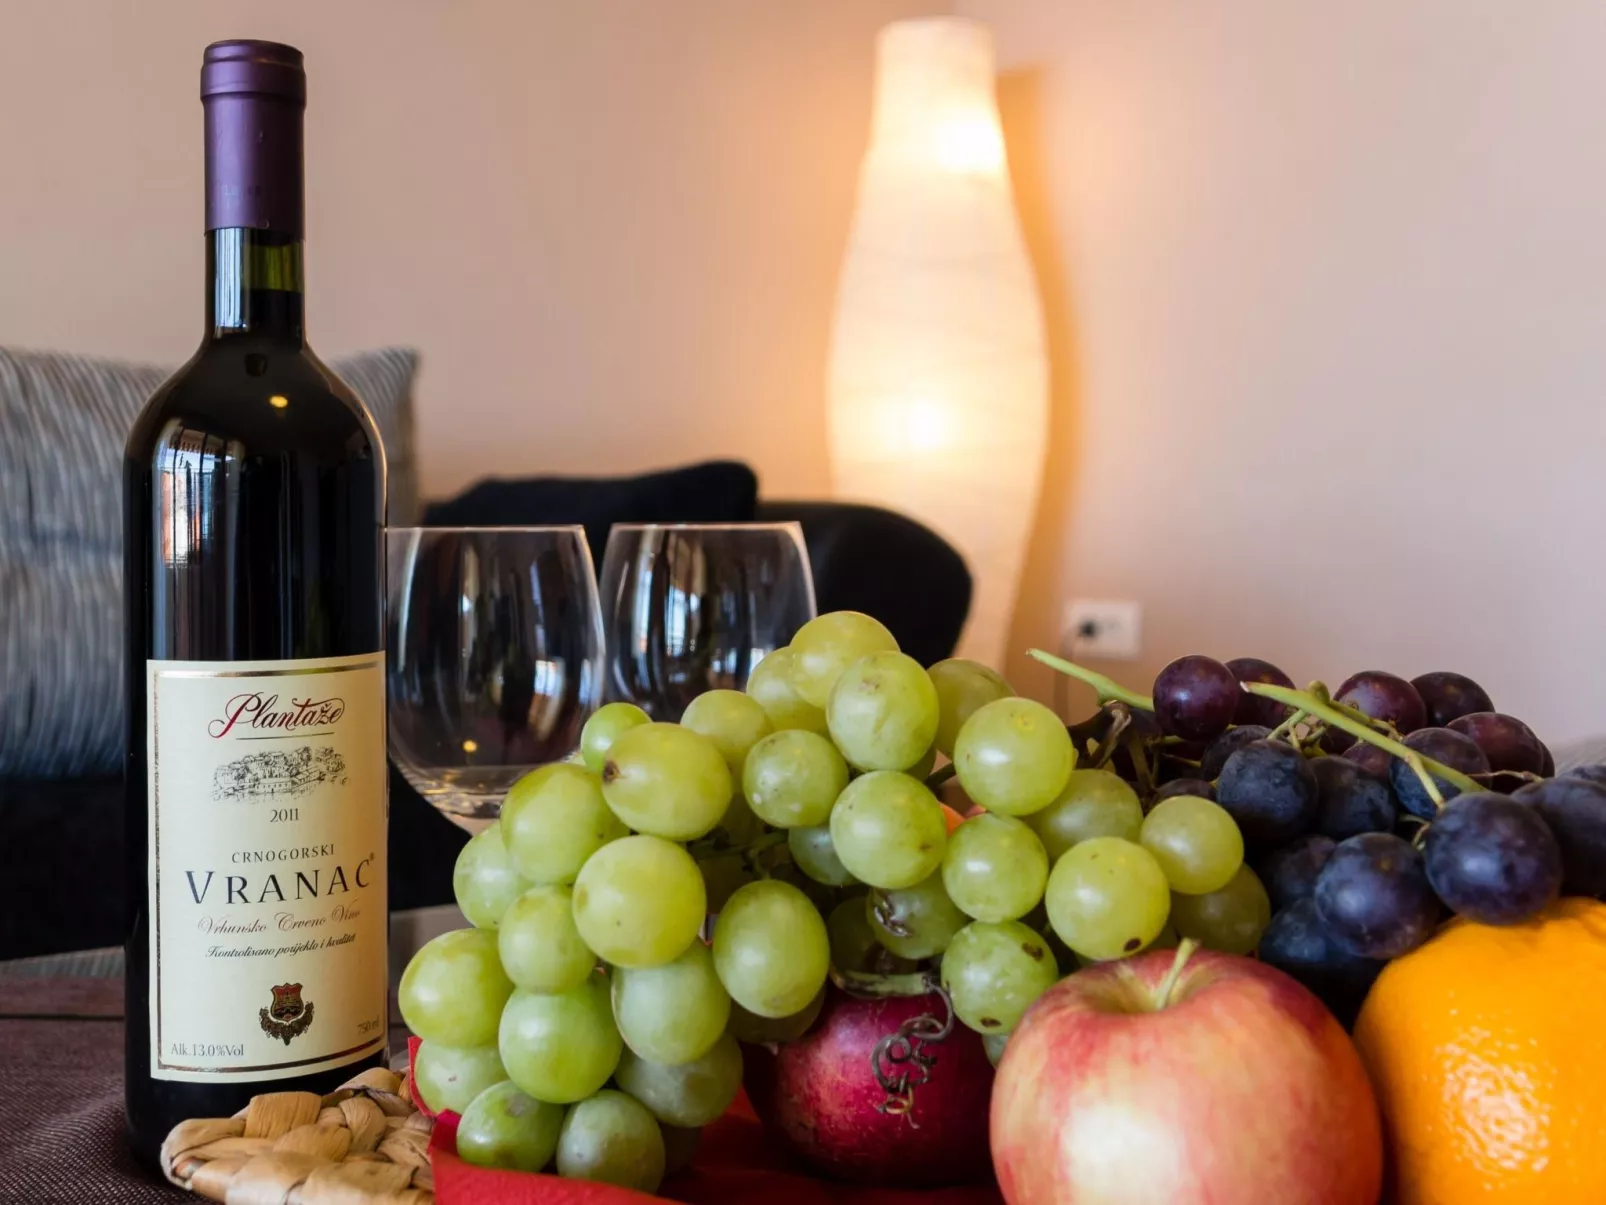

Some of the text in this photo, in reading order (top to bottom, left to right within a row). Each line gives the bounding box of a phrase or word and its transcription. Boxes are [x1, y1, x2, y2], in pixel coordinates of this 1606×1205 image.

[207, 691, 345, 739] Plantaže
[269, 808, 299, 823] 2011
[231, 843, 335, 864] CRNOGORSKI
[198, 899, 361, 936] Vrhunsko Crveno Vino
[205, 945, 275, 958] Kontrolisano
[275, 939, 318, 958] porijeklo
